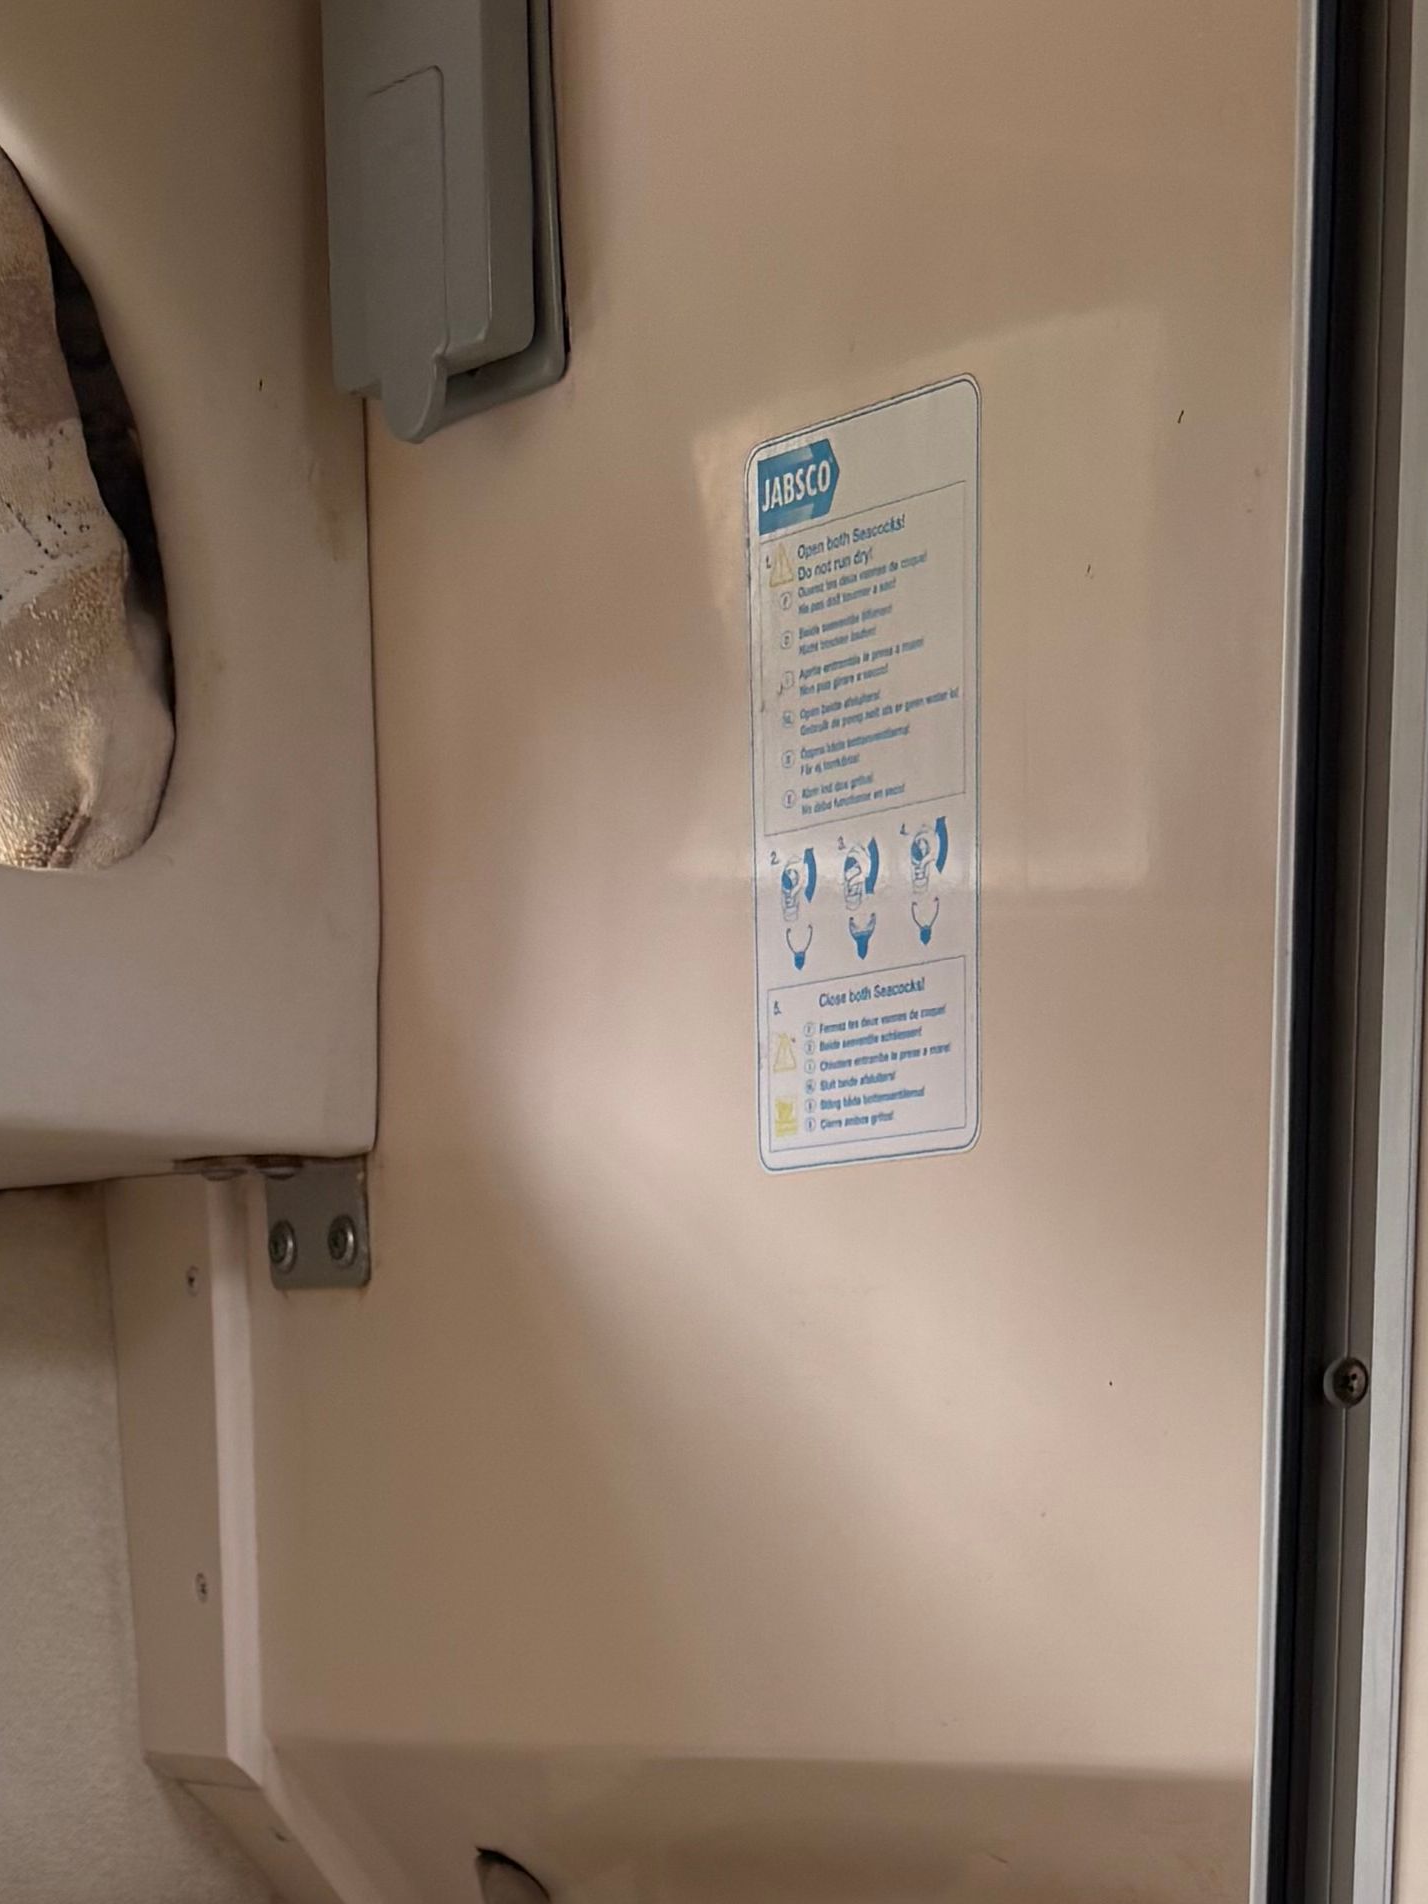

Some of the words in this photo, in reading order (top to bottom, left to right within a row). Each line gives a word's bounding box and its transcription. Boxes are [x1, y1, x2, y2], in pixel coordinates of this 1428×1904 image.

[761, 460, 831, 512] JABSCO
[797, 538, 824, 560] Open
[827, 532, 850, 550] both
[852, 514, 906, 543] Seacocks!
[797, 565, 812, 581] Do
[814, 562, 832, 576] not
[834, 555, 851, 570] run
[849, 986, 872, 1003] both
[873, 976, 926, 999] Seacocks!
